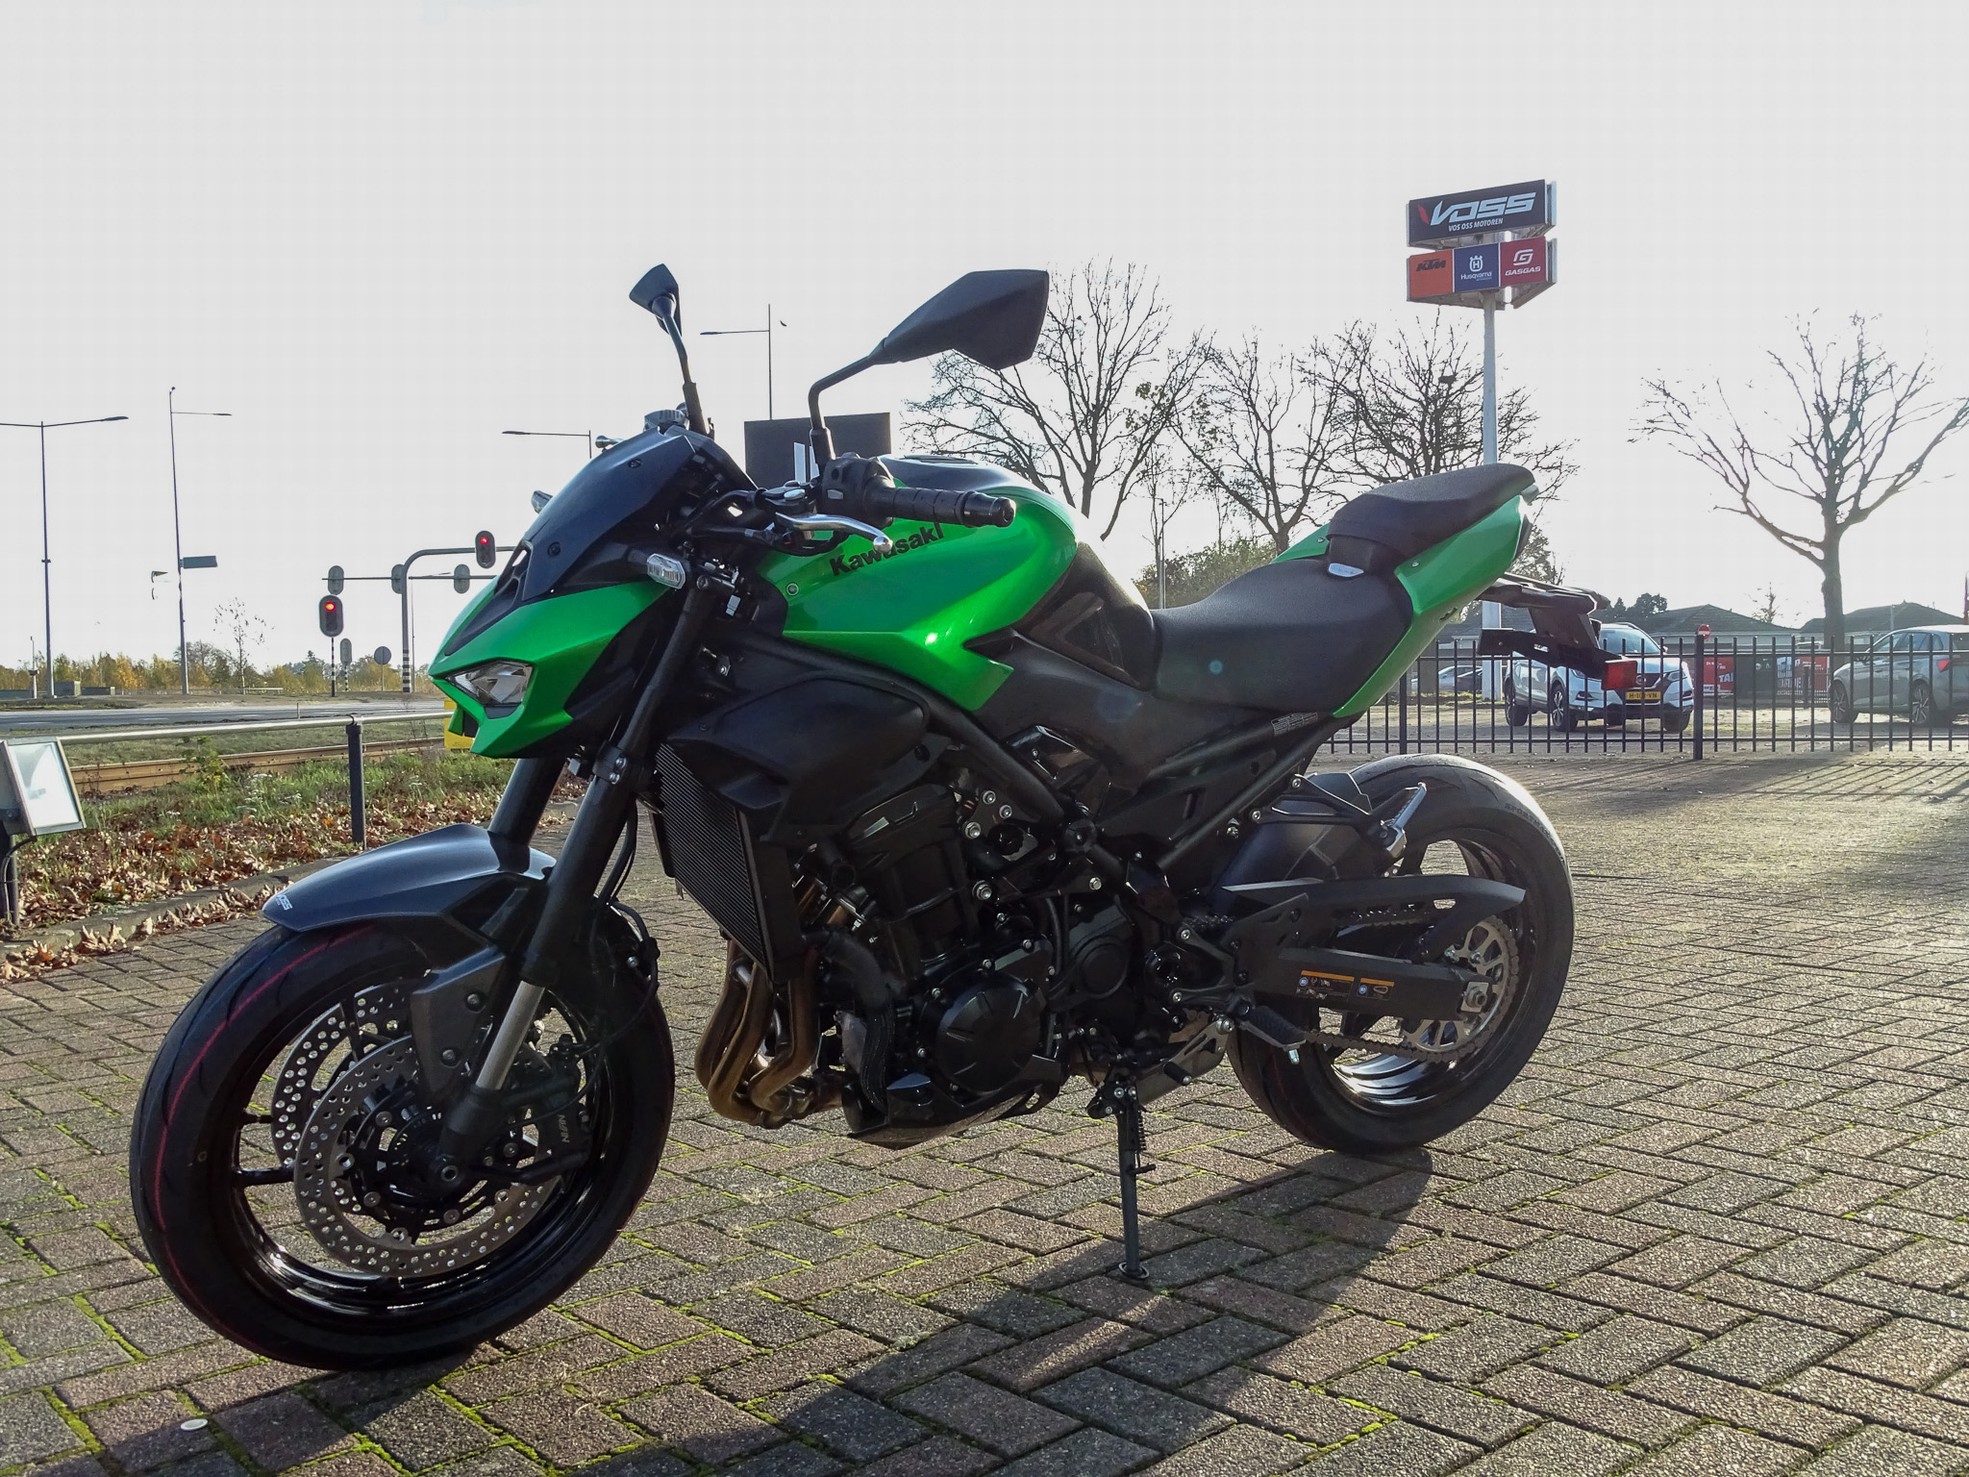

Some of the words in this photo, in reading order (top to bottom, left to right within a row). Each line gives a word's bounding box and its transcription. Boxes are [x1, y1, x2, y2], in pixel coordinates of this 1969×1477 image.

[1430, 192, 1536, 225] VOSS
[1448, 223, 1461, 232] VOS
[1461, 221, 1474, 229] OSS
[1473, 218, 1504, 228] MOTOREN
[1460, 271, 1492, 280] Husqvarna
[1504, 266, 1541, 276] GASGAS
